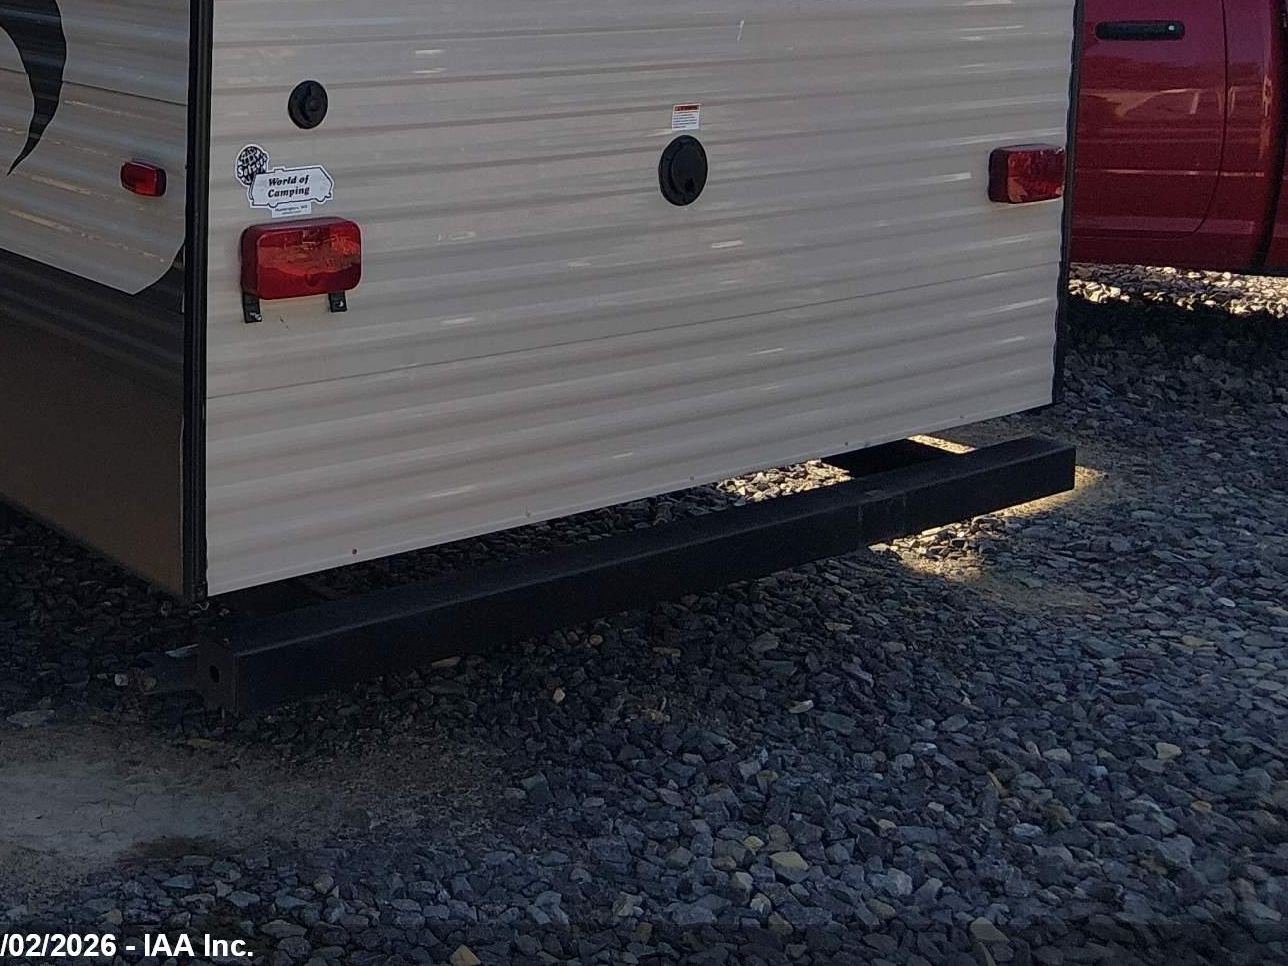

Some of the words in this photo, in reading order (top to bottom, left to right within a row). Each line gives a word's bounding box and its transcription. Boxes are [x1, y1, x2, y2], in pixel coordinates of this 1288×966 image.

[268, 175, 297, 186] World
[299, 174, 310, 184] of
[267, 186, 310, 198] Camping
